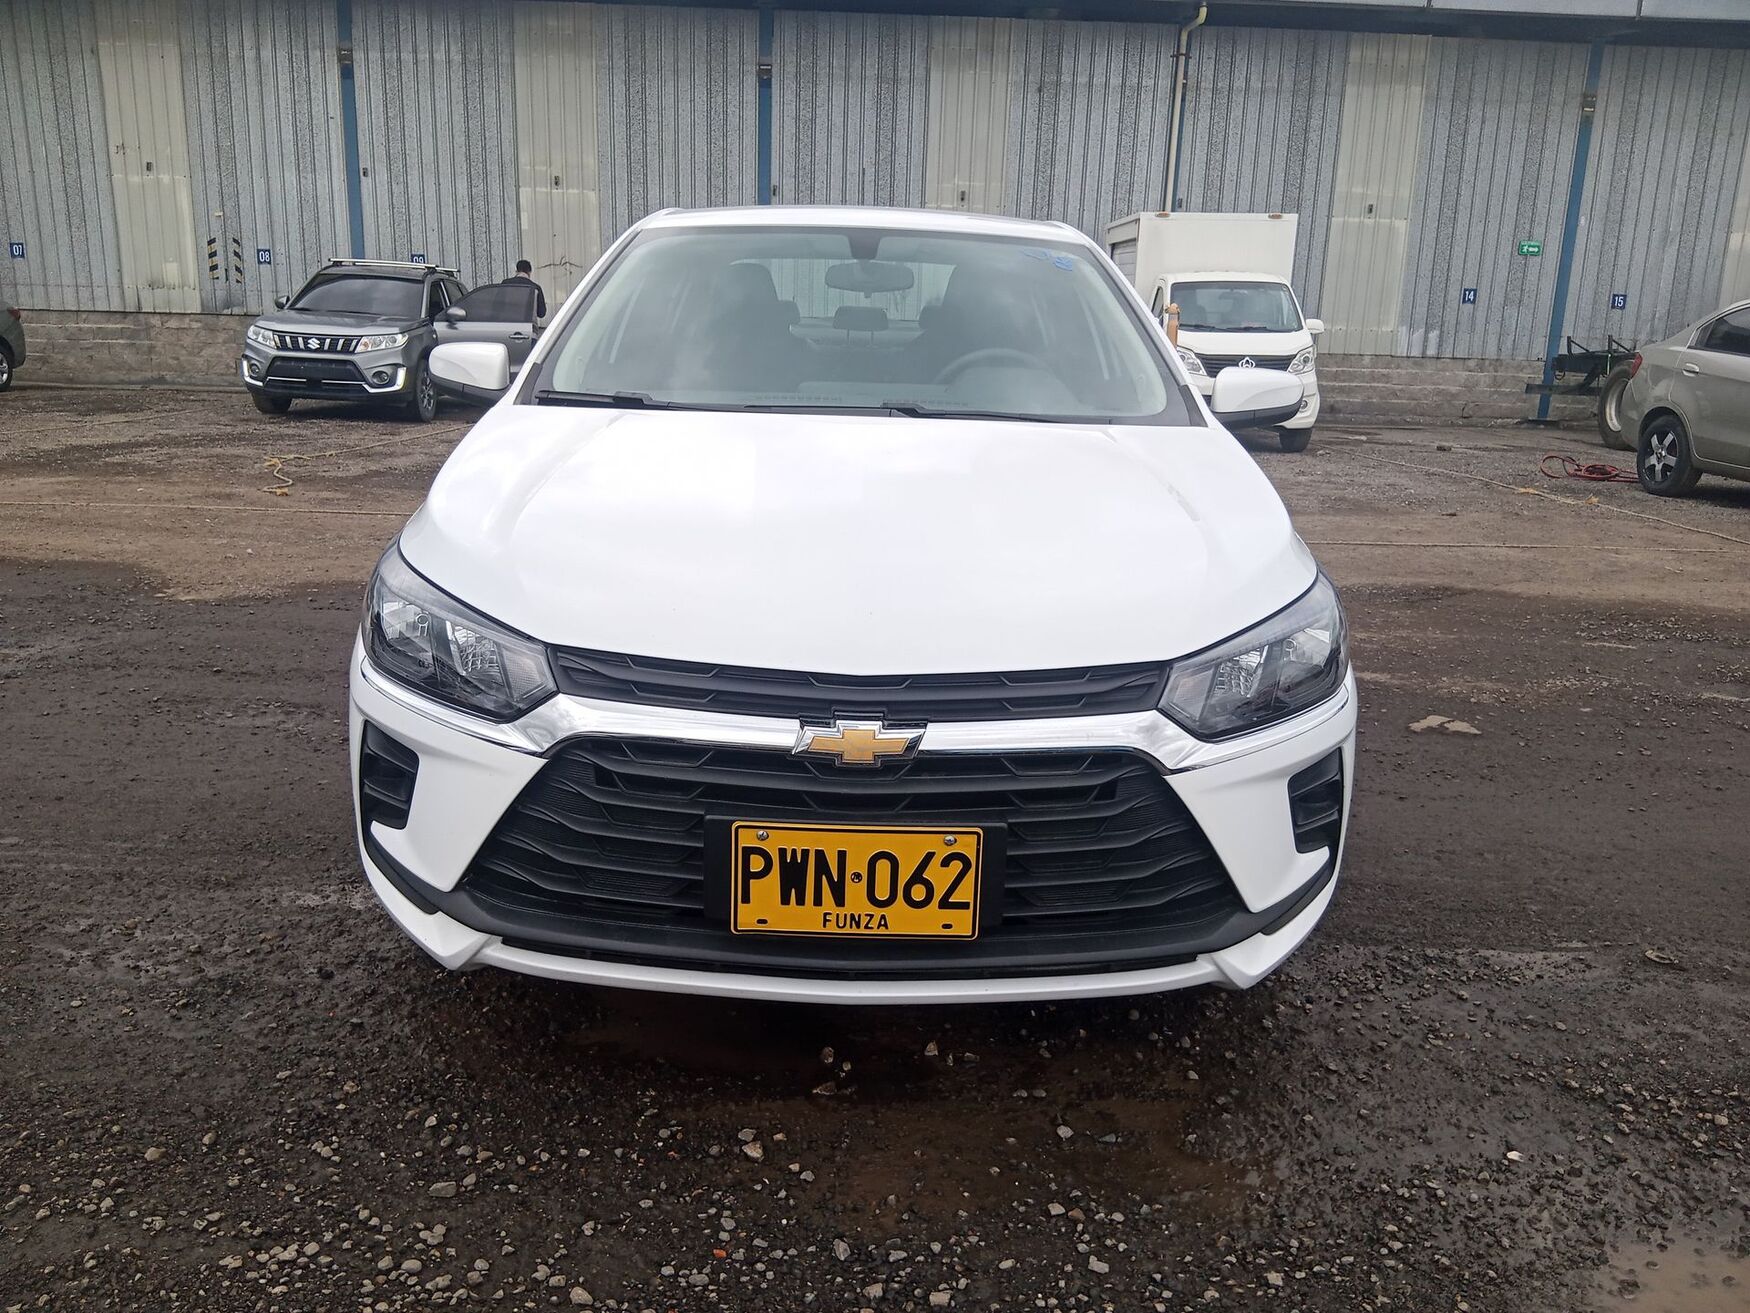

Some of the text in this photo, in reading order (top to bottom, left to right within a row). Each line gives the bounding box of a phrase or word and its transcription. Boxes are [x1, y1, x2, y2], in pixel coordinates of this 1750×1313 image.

[13, 245, 23, 255] 07
[259, 251, 270, 262] 08
[1465, 291, 1474, 301] 14
[1614, 296, 1624, 307] 15
[822, 912, 889, 930] FUNZA
